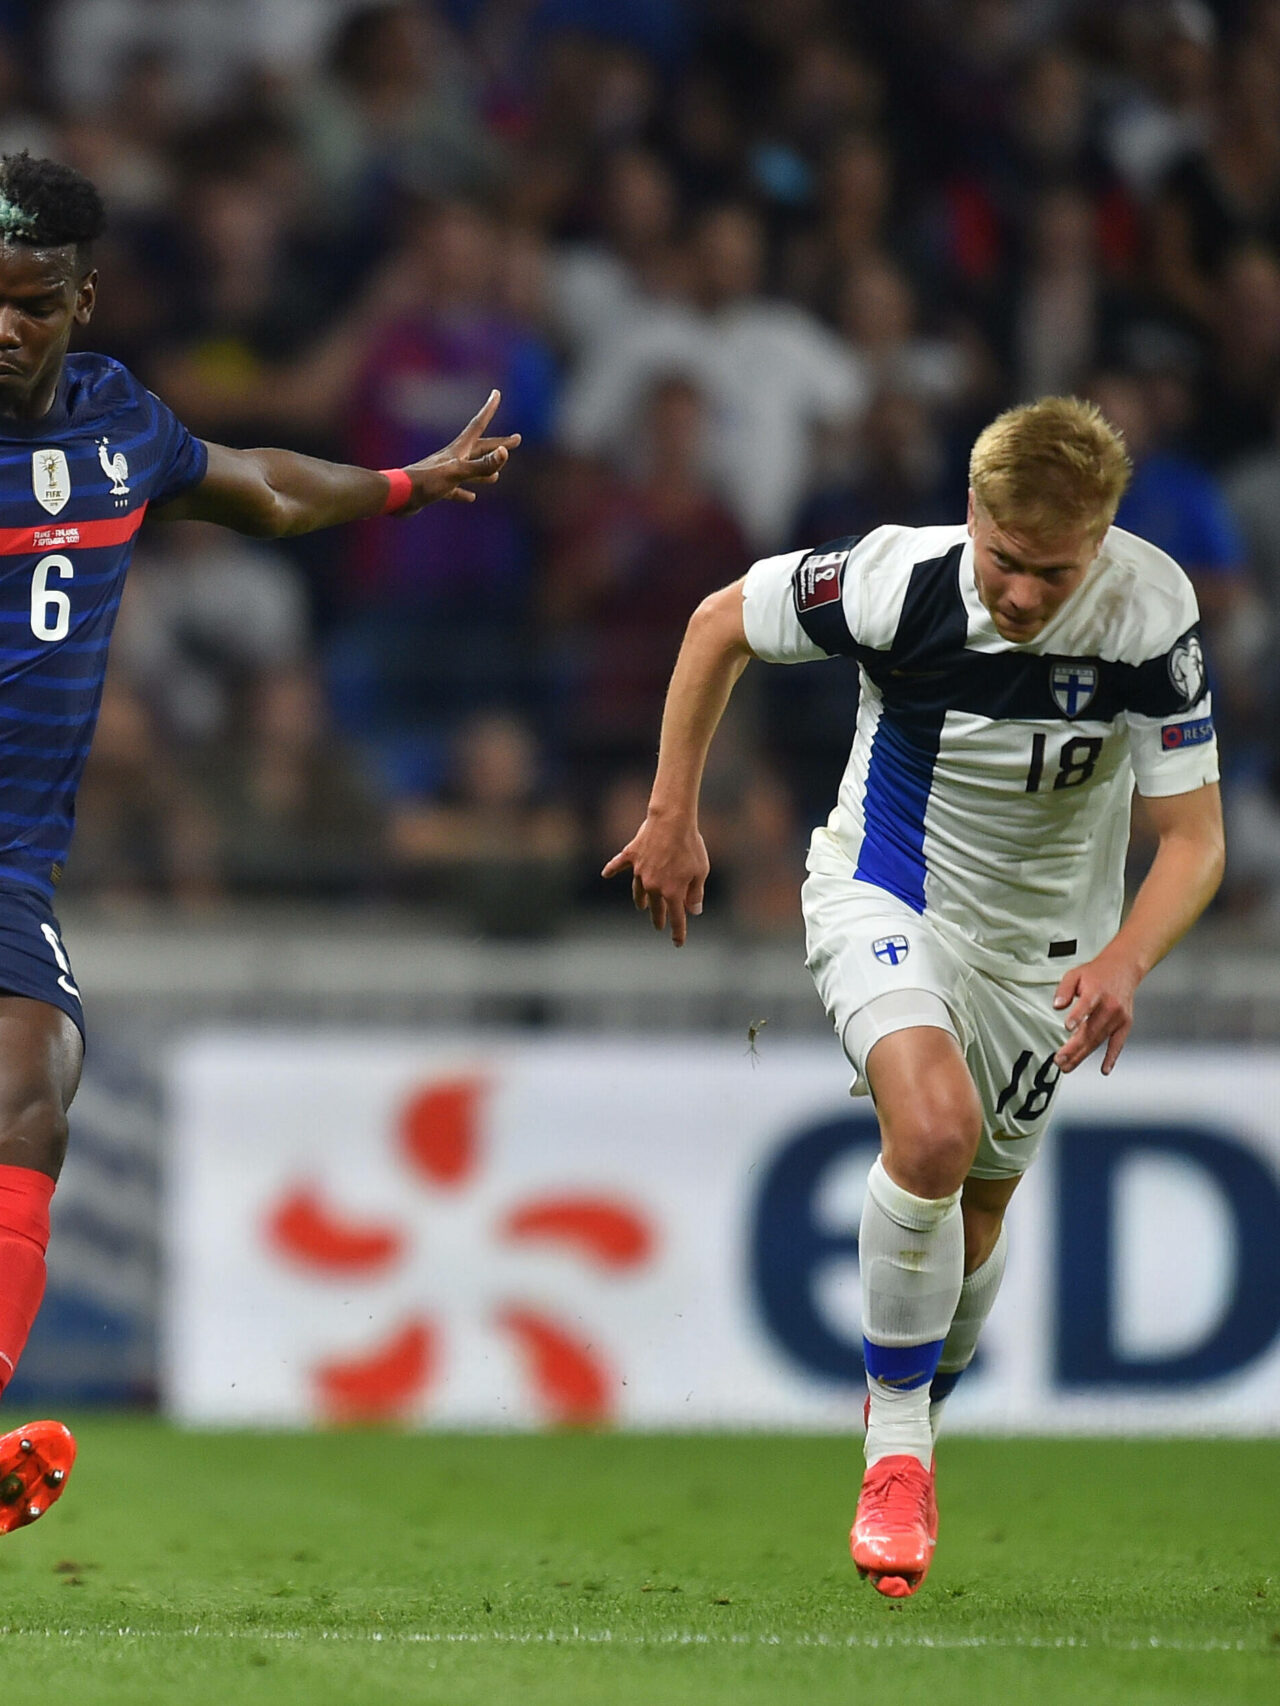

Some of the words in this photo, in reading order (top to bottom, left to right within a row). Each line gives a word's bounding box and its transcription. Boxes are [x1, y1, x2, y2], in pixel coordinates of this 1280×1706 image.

[45, 490, 61, 498] FIFA
[30, 554, 74, 642] 6
[1025, 733, 1103, 793] 18
[995, 1050, 1061, 1121] 18
